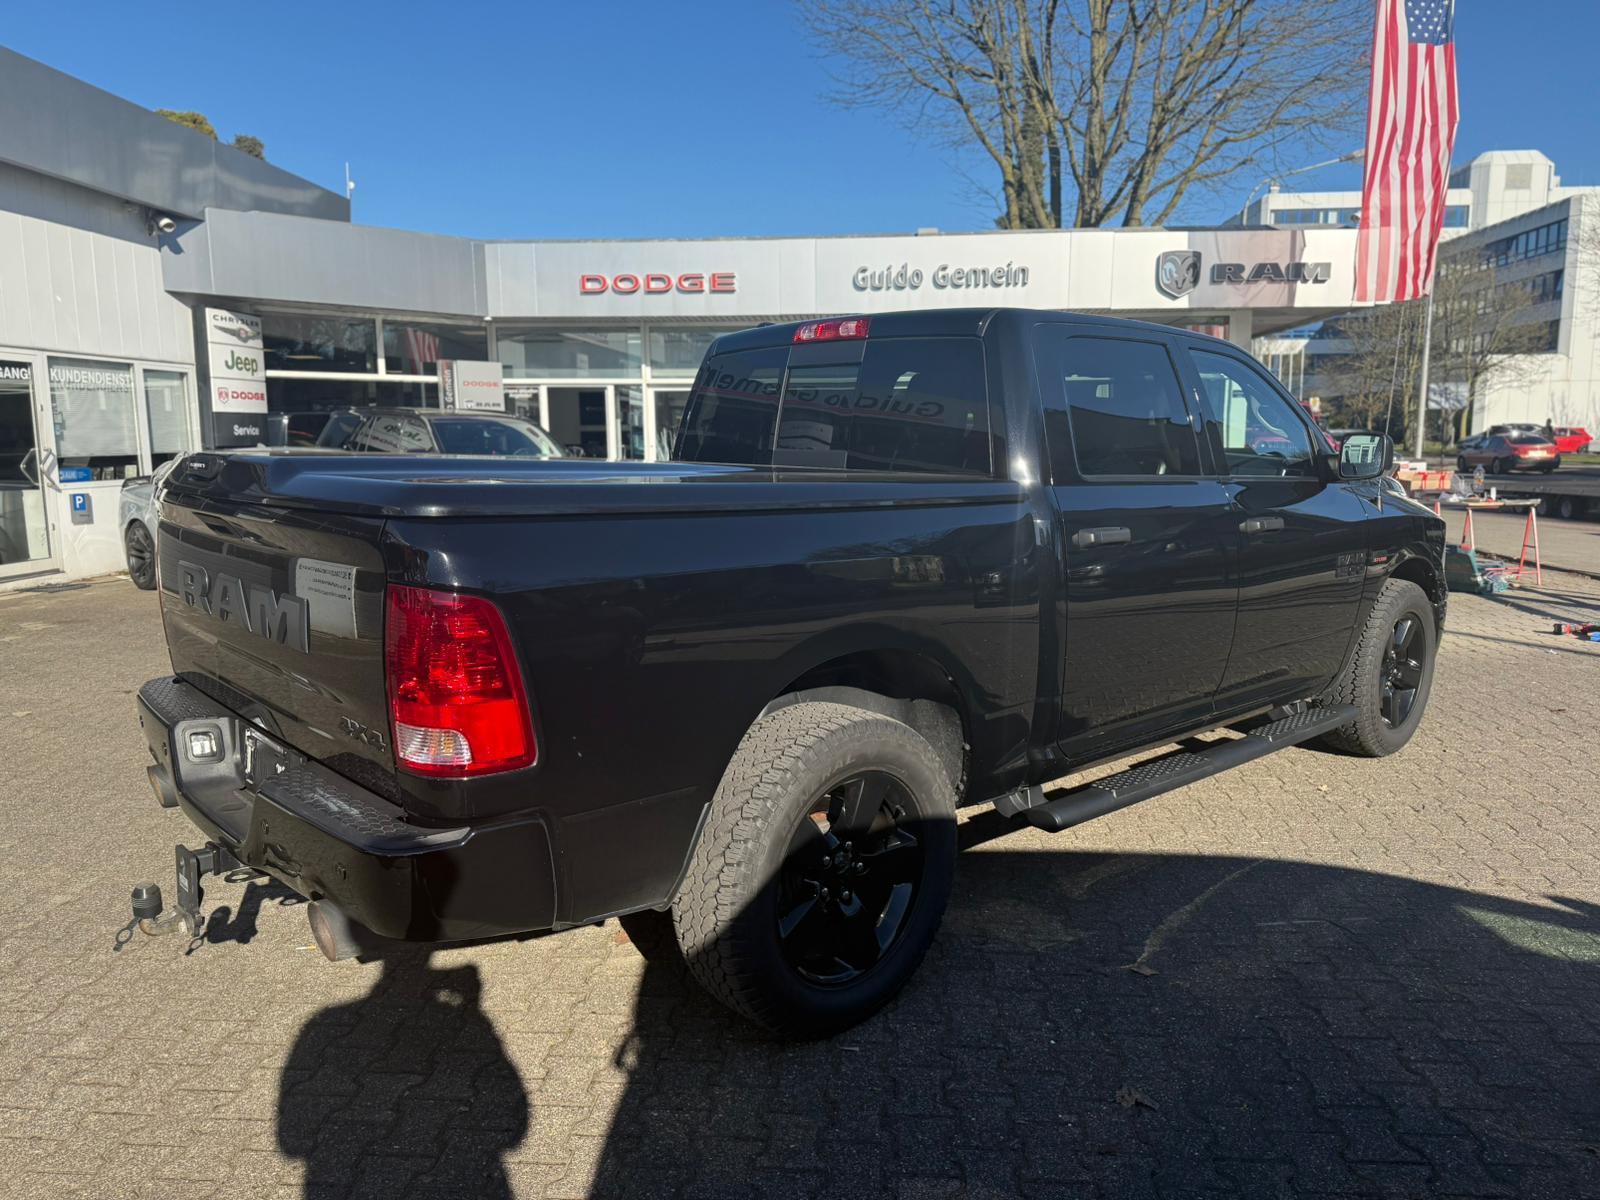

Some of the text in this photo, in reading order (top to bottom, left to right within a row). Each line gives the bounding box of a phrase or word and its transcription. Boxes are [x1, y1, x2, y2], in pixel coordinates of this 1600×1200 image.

[853, 261, 1030, 291] Guido Gemein
[1210, 262, 1332, 286] RAM
[580, 273, 736, 295] DODGE
[212, 314, 259, 328] CHRYSLER
[225, 350, 258, 376] Jeep
[49, 367, 130, 386] KUNDENDIENST
[463, 380, 500, 388] DODGE
[231, 391, 265, 401] DODGE
[233, 424, 260, 436] Service
[75, 496, 84, 509] P
[177, 560, 311, 655] RAM
